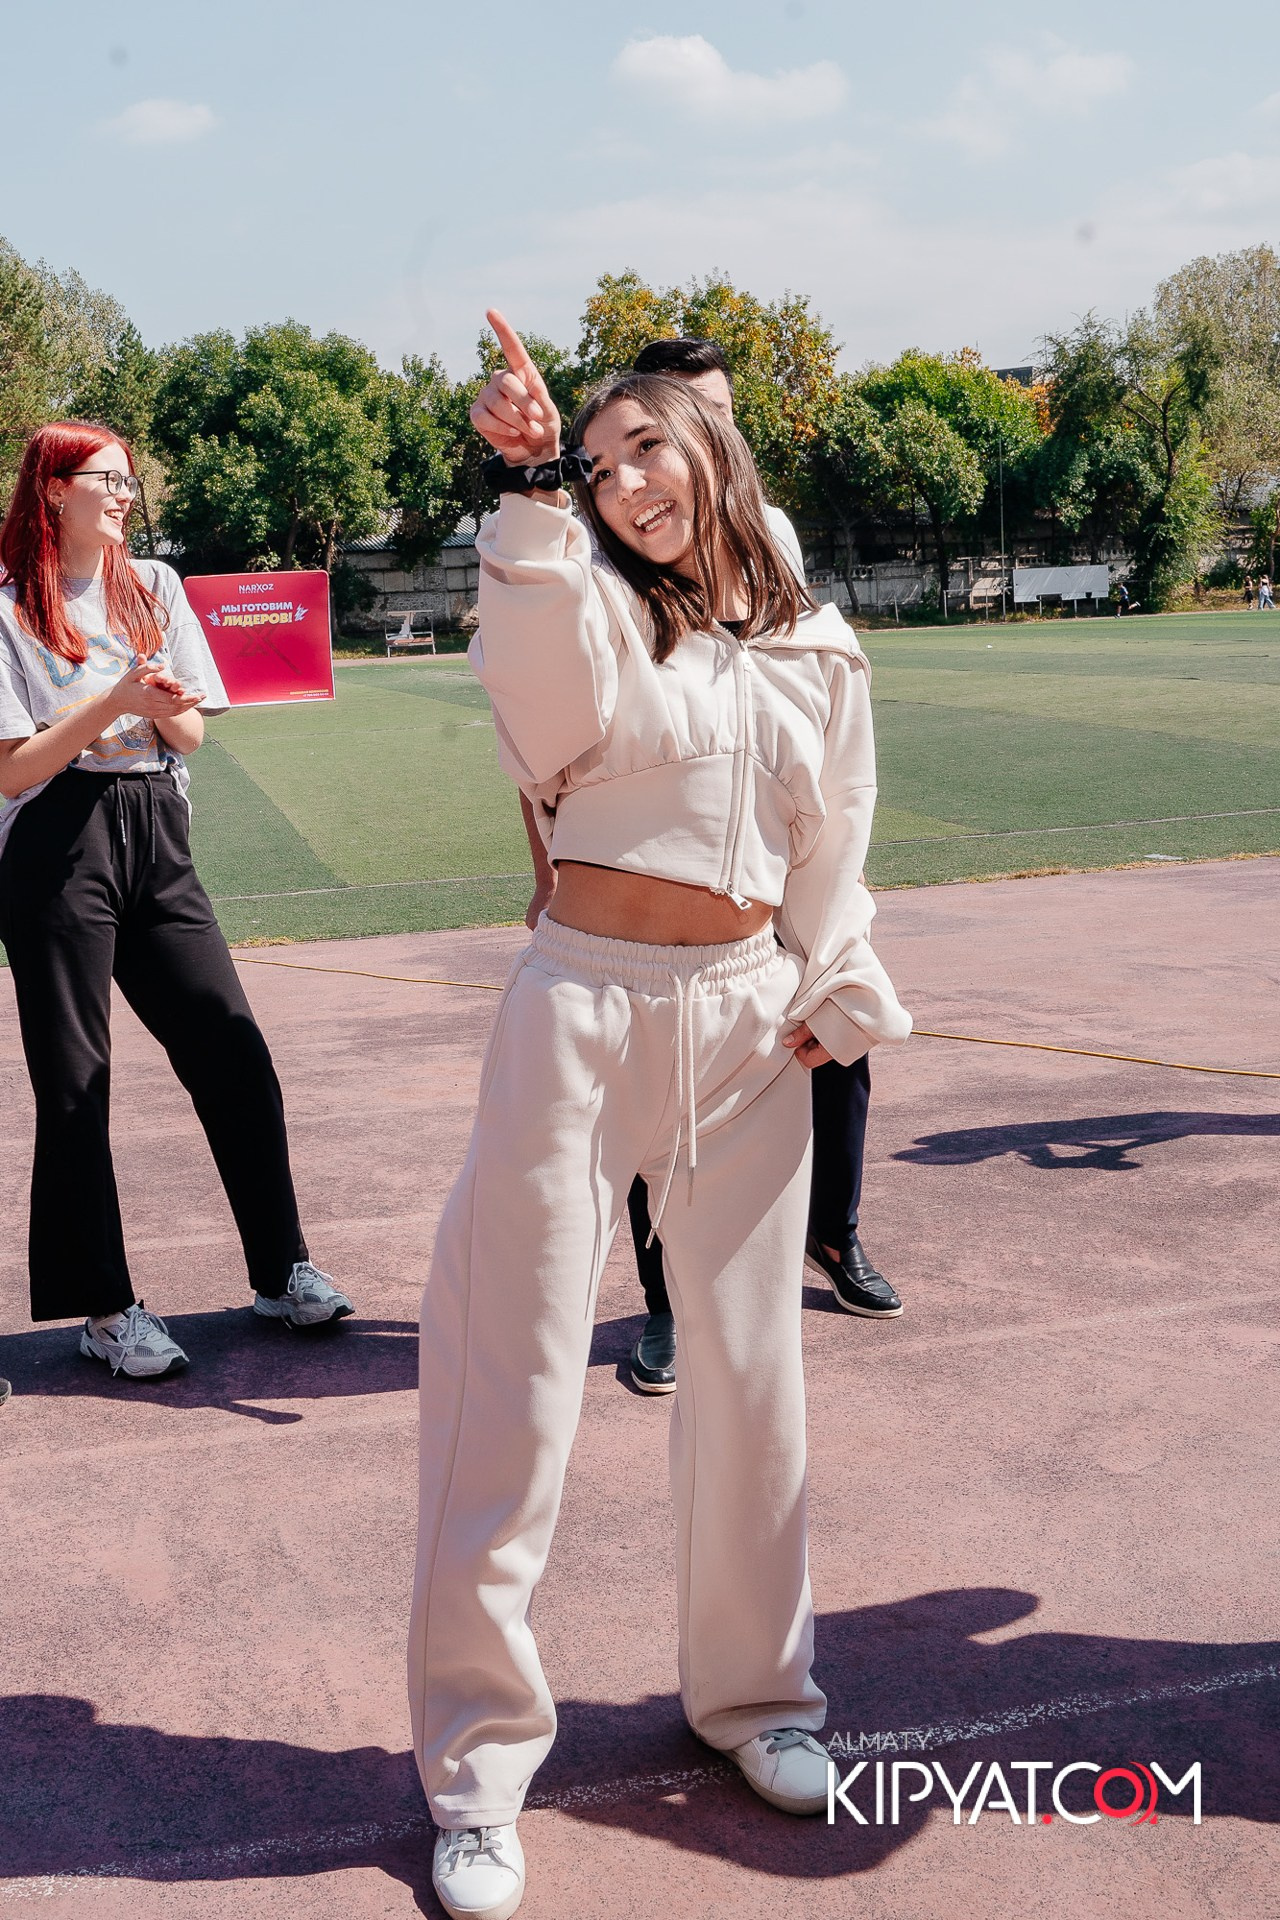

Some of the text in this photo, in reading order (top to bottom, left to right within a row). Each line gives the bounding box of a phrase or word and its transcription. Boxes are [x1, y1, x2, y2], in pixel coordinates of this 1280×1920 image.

[239, 583, 274, 593] NARXOZ
[221, 602, 293, 613] МЫ ГОТОВИМ
[222, 612, 293, 627] ЛИДЕРОВ!
